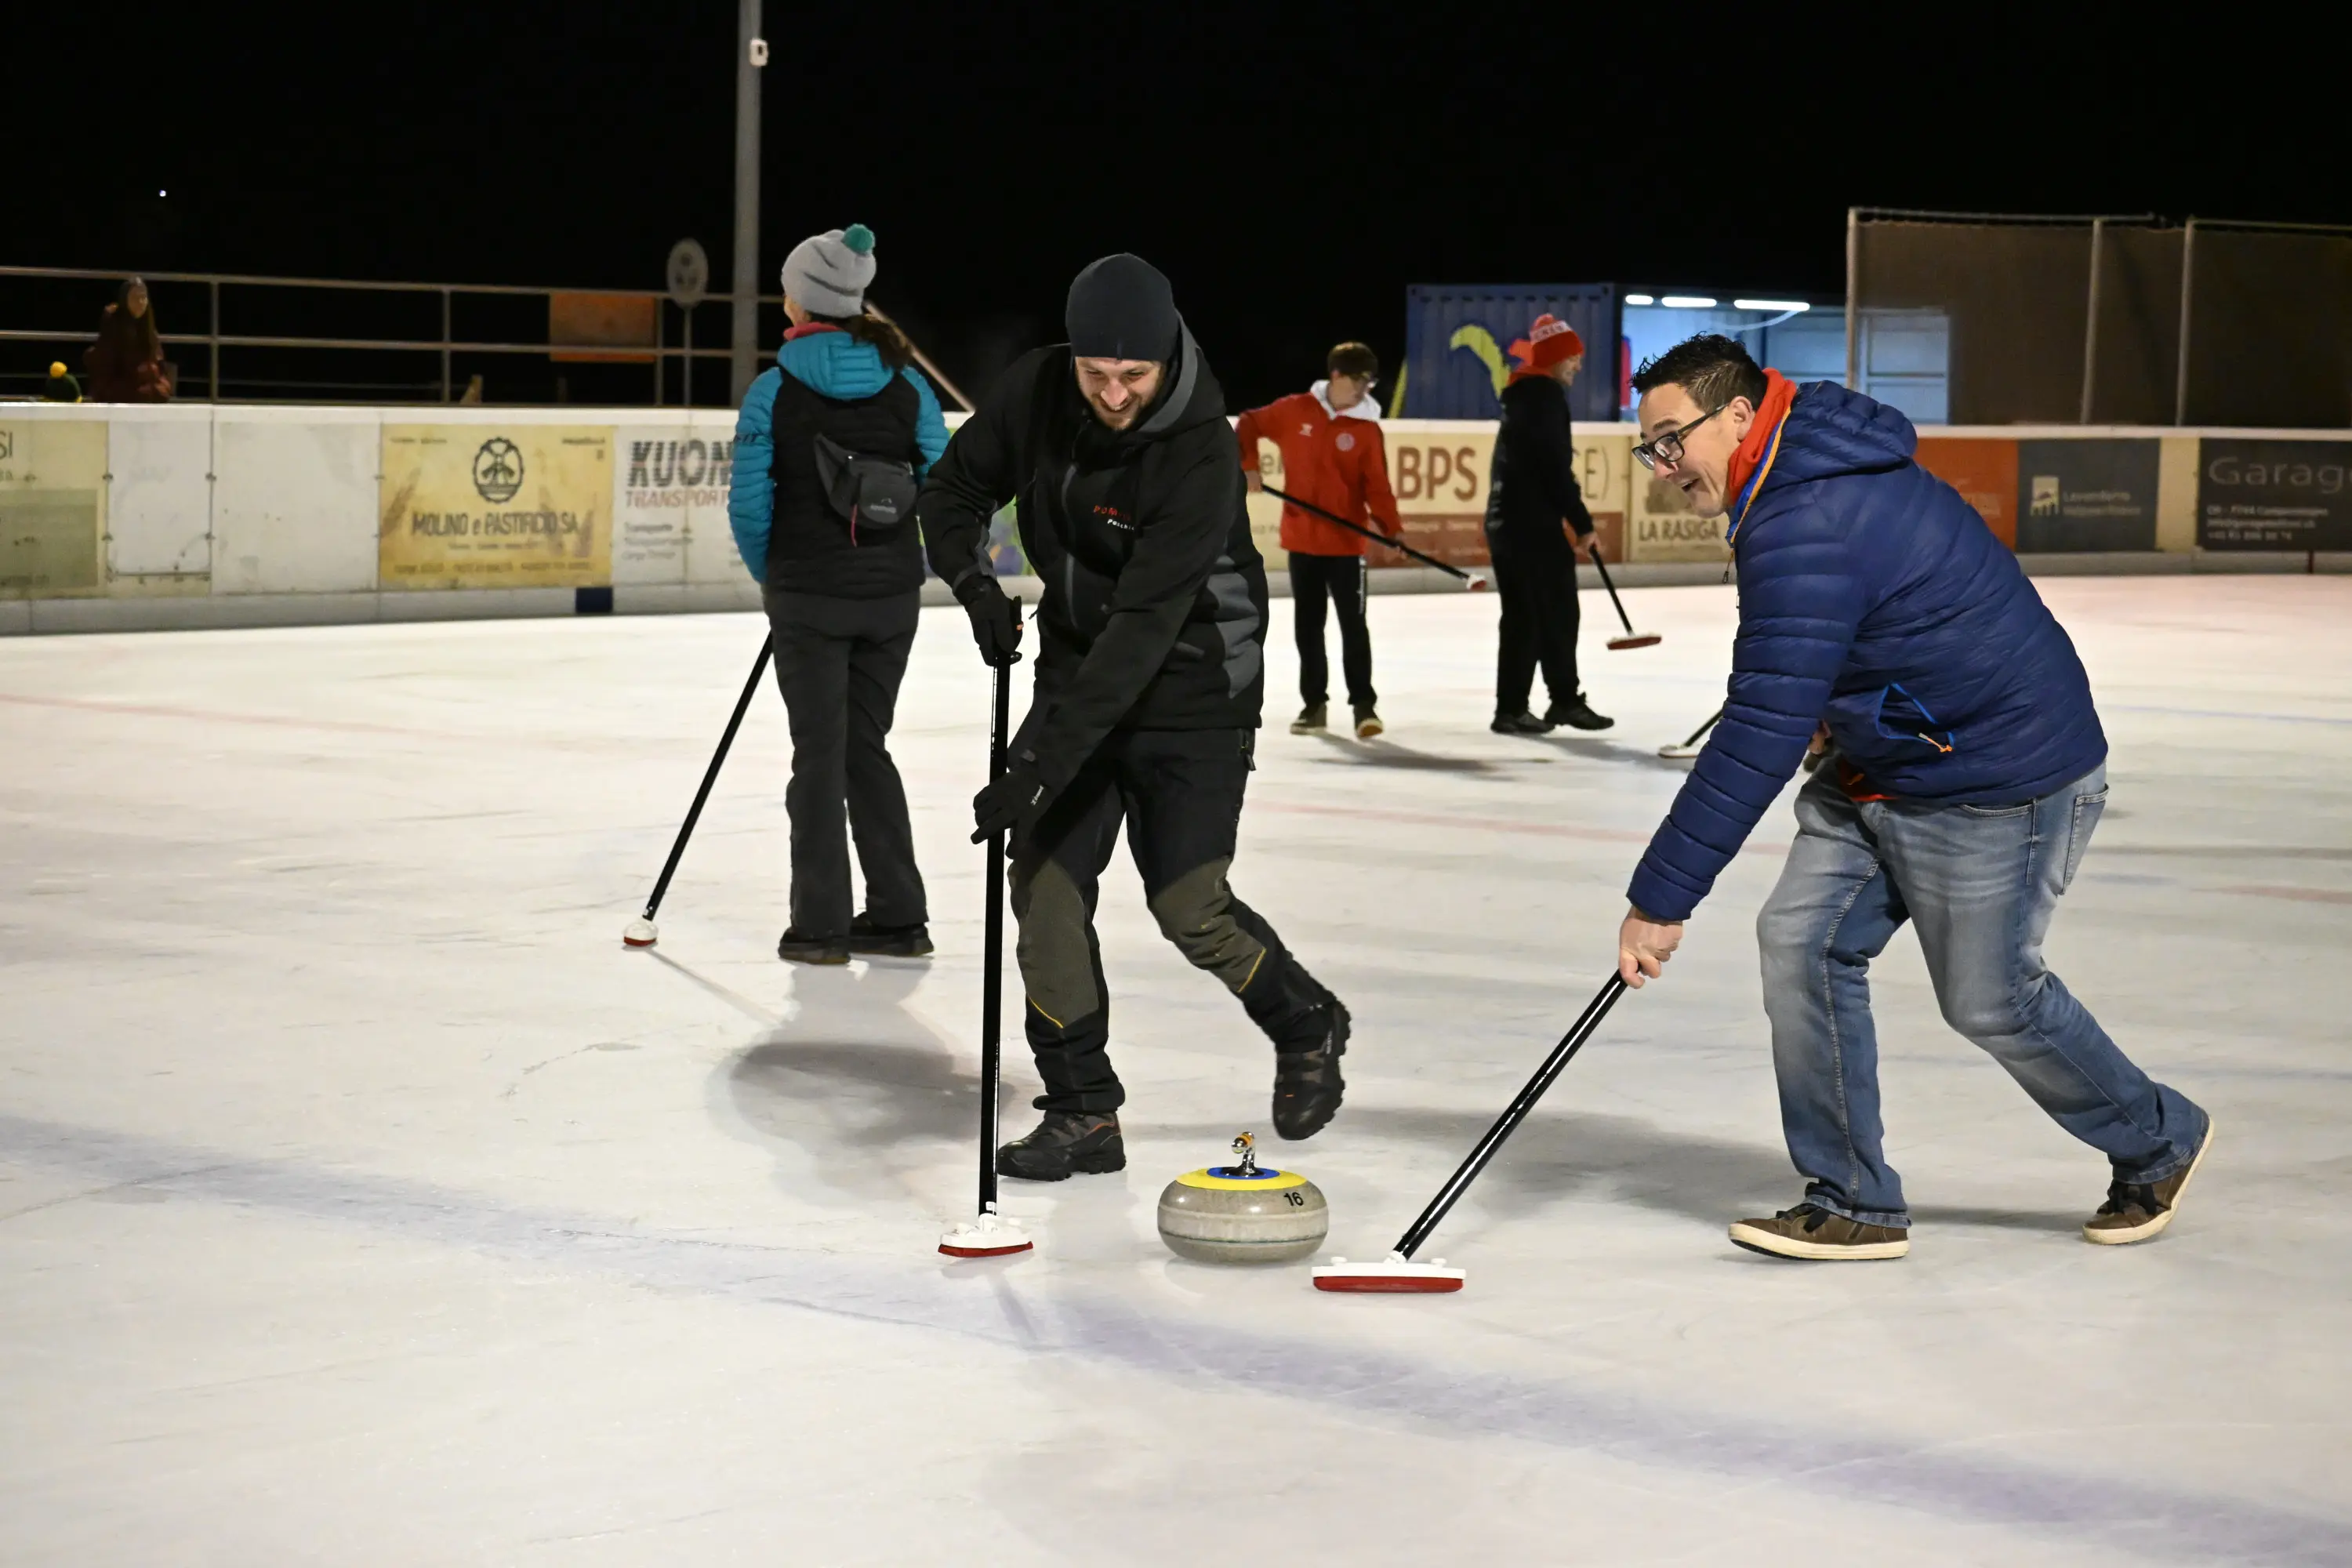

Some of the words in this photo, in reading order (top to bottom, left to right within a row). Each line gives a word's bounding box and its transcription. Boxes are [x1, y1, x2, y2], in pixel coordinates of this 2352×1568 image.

[628, 439, 735, 487] KUON
[1397, 445, 1478, 502] BPS
[2209, 456, 2352, 494] Garag
[625, 489, 729, 510] TRANSPORT
[412, 511, 468, 536] MOLINO
[485, 511, 557, 536] PASTIFICIO
[1639, 521, 1659, 542] LA
[1662, 520, 1719, 542] RASIGA
[1283, 1192, 1305, 1207] 16
